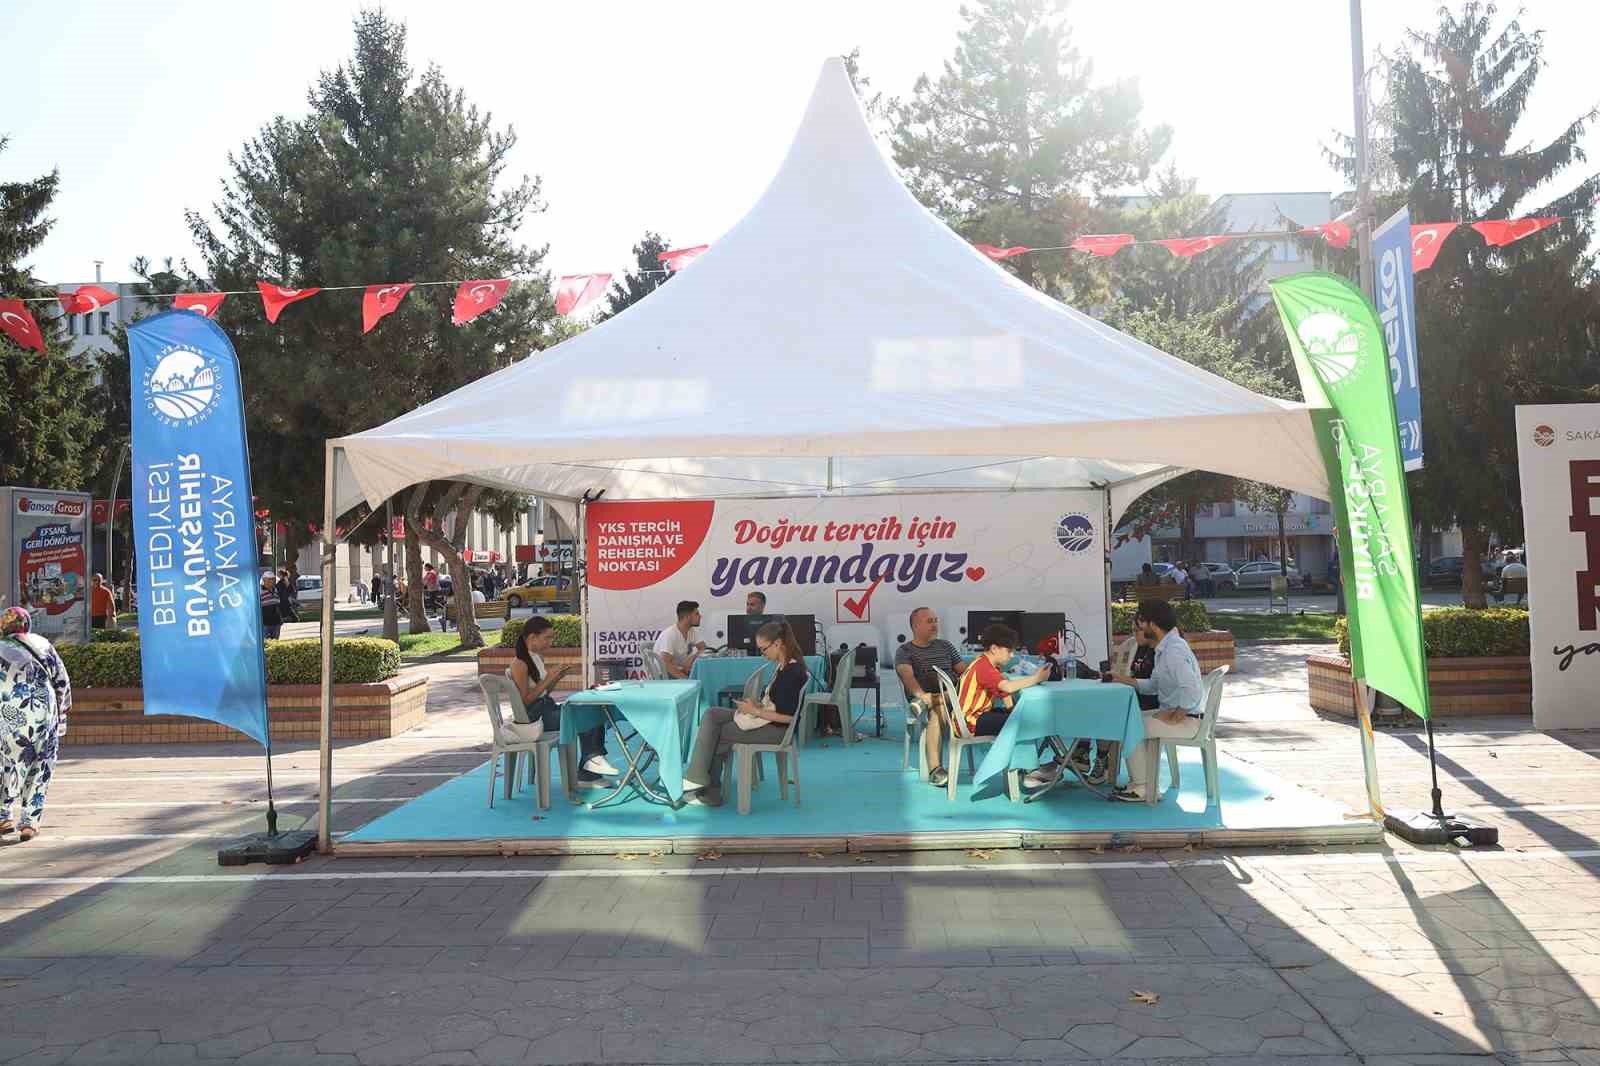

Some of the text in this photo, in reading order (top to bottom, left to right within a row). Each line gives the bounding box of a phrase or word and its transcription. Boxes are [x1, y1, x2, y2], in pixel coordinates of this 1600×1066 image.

[57, 502, 81, 513] Gross
[40, 526, 68, 537] EFSANE
[598, 520, 680, 533] YKS TERCİH
[734, 516, 957, 549] Doğru tercih için
[598, 534, 684, 547] DANIŞMA VE
[598, 546, 676, 559] REHBERLİK
[598, 561, 660, 573] NOKTASI
[709, 543, 968, 597] yanındayız
